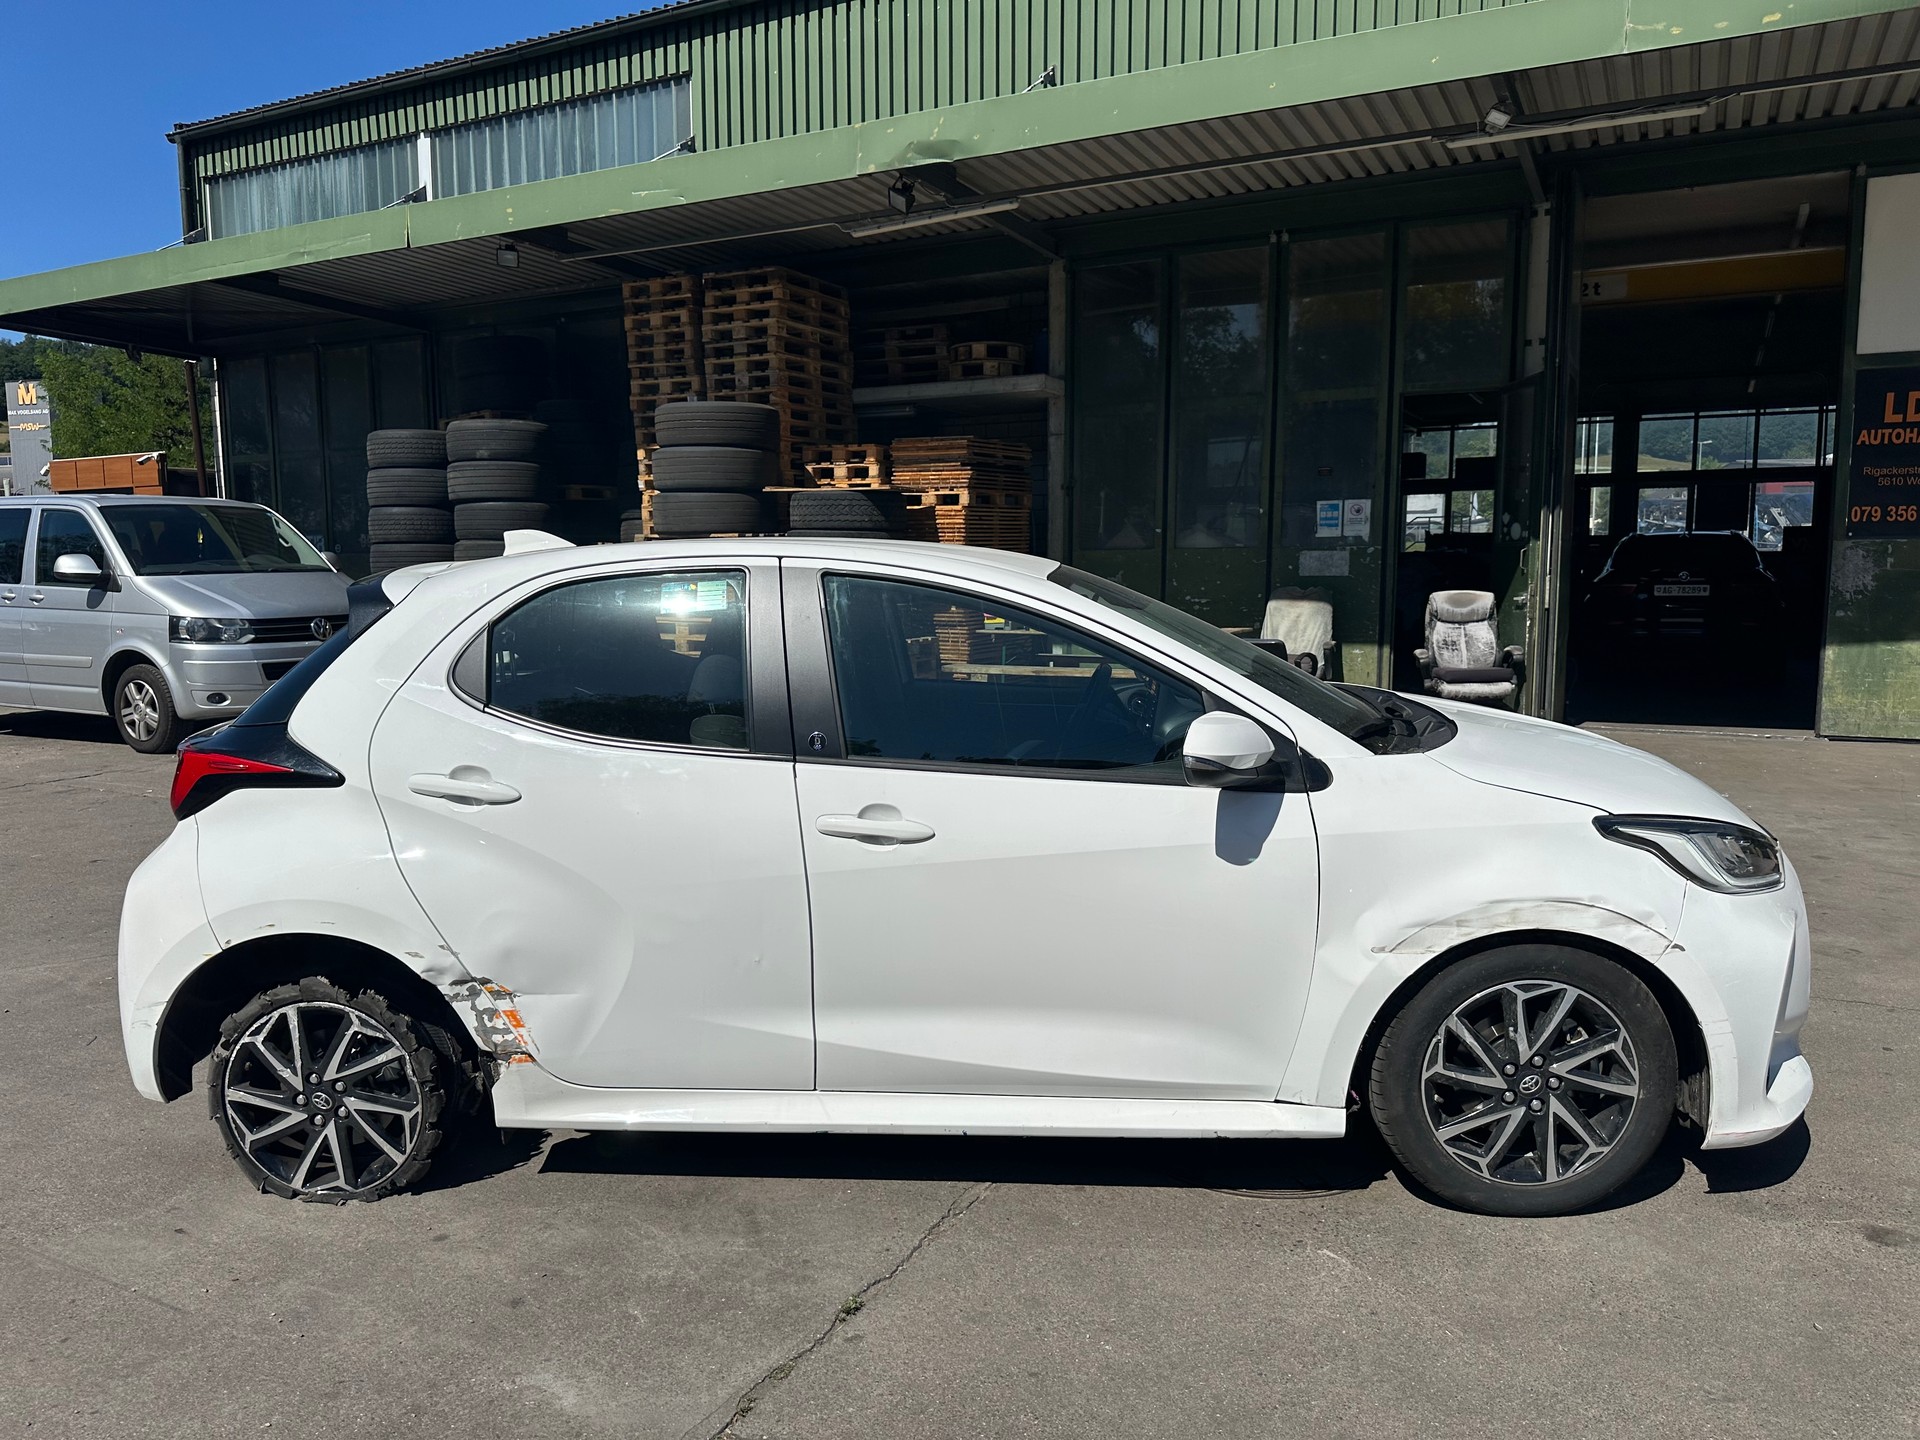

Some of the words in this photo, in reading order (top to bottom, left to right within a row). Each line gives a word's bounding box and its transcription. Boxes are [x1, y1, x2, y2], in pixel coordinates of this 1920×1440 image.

[1857, 428, 1920, 445] AUTOH
[1877, 477, 1904, 486] 5610
[1851, 506, 1881, 522] 079
[1886, 505, 1917, 522] 356
